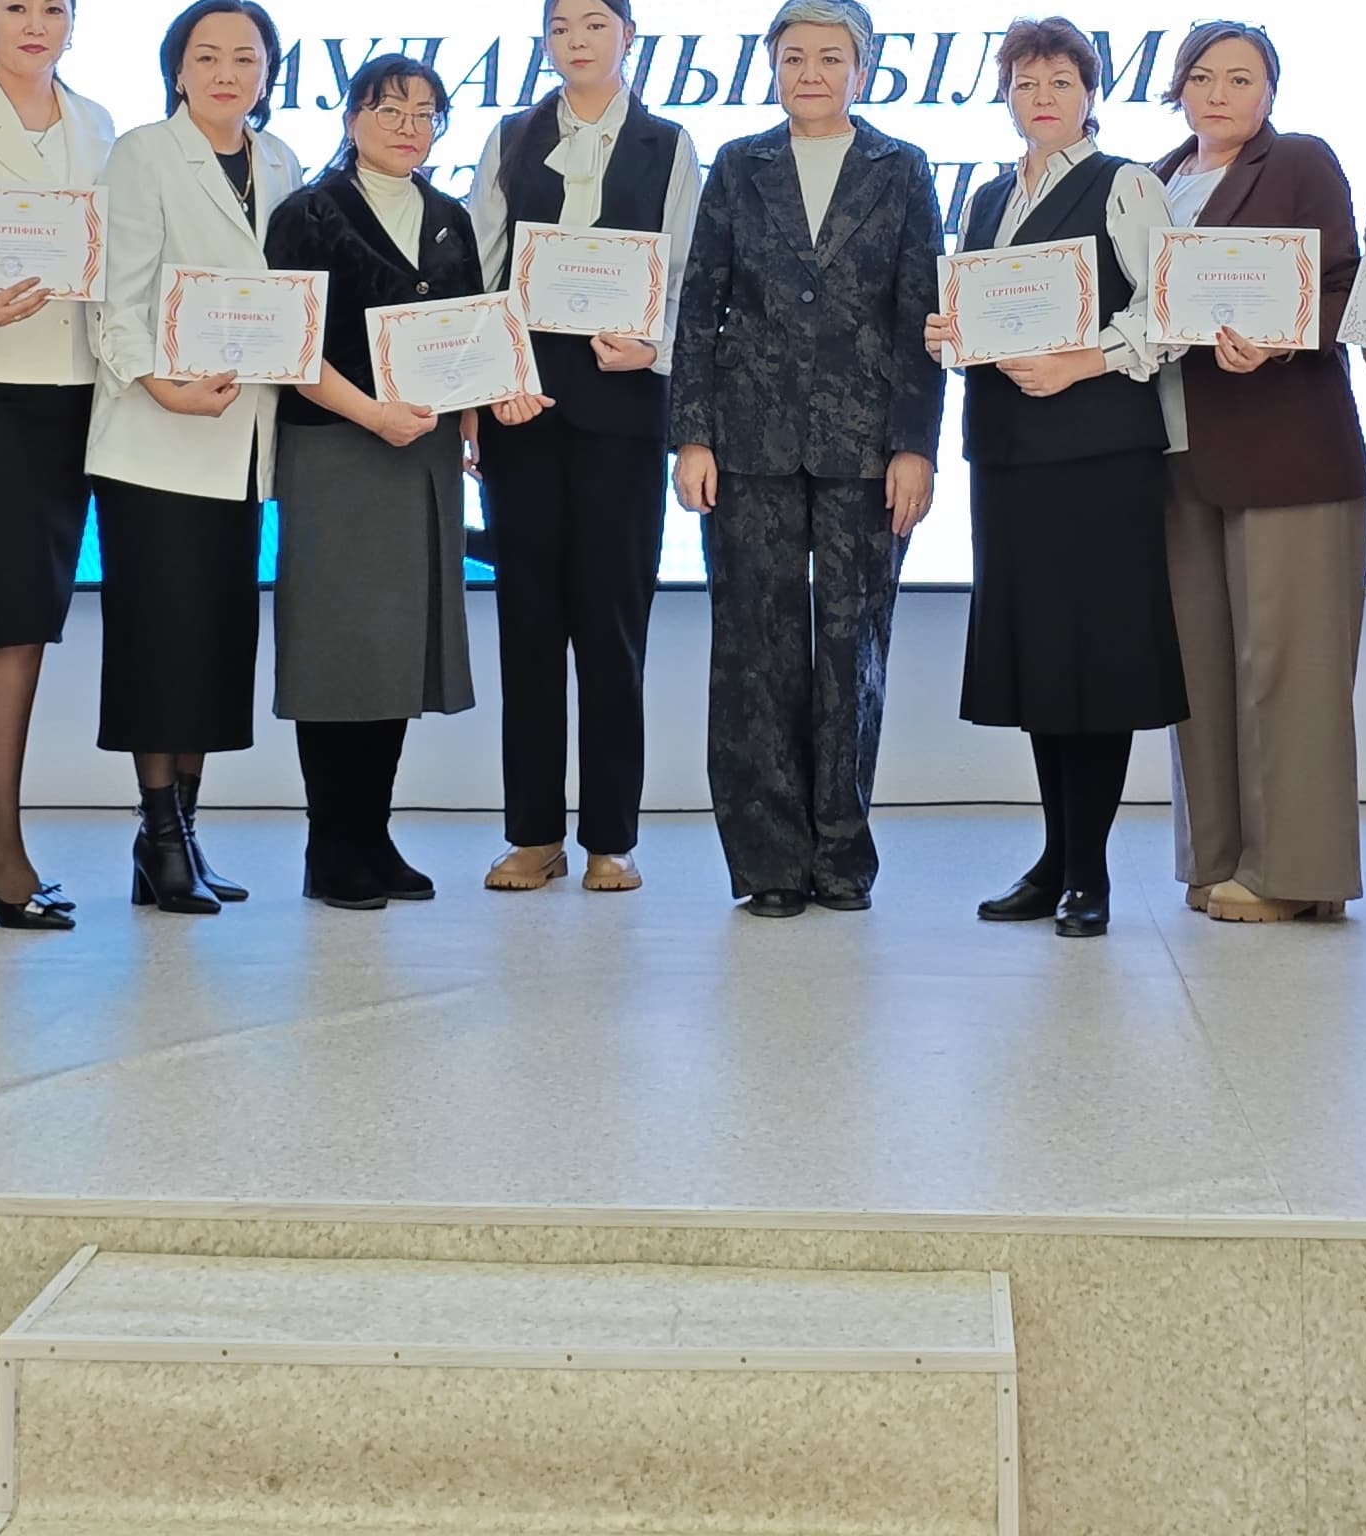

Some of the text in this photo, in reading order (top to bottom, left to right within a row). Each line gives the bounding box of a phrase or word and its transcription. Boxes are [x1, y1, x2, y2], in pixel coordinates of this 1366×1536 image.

[557, 264, 622, 276] СЕРТИФИКАТ
[1196, 272, 1268, 281] СЕРТИФИКАТ
[985, 282, 1051, 298] СЕРТИФИКАТ
[207, 311, 276, 321] СЕРТИФИКАТ
